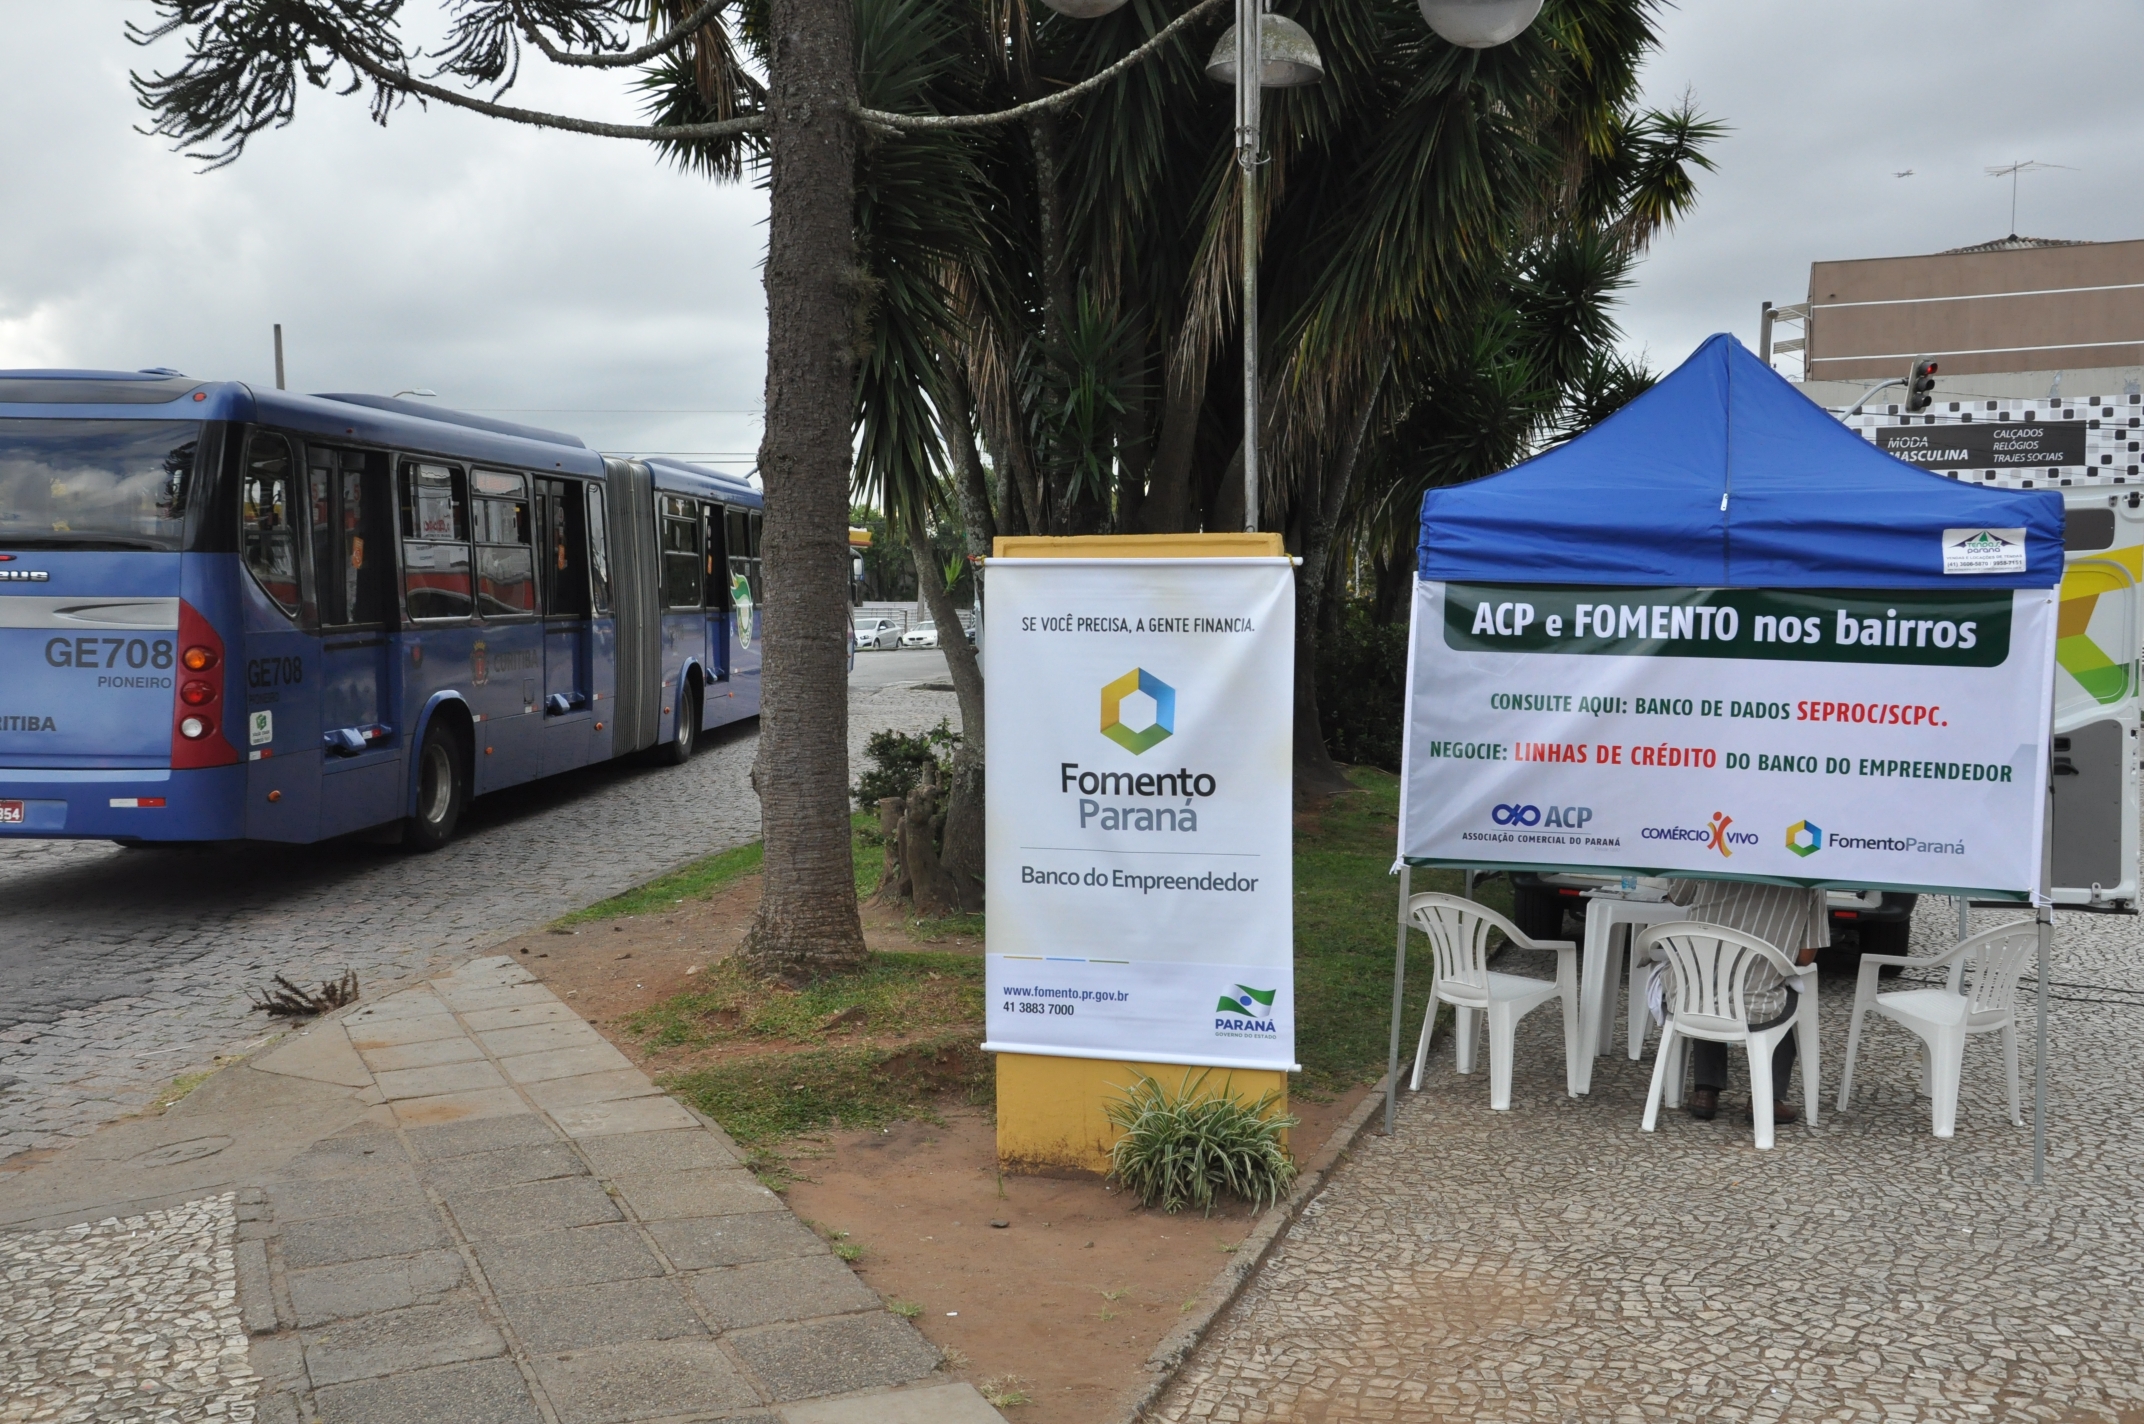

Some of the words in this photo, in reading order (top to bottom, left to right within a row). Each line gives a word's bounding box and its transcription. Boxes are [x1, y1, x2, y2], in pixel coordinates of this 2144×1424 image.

[1887, 436, 1928, 448] MODA
[1993, 429, 2044, 440] CALÇADOS
[1993, 440, 2039, 450] RELÓGIOS
[1993, 453, 2025, 463] TRAJES
[2027, 452, 2064, 462] SOCIAIS
[1021, 617, 1036, 632] SE
[1041, 613, 1074, 632] VOCÊ
[1077, 617, 1132, 634] PRECISA,
[1136, 618, 1145, 632] A
[1149, 617, 1190, 633] GENTE
[1194, 617, 1255, 633] FINANCIA.
[1471, 601, 1536, 636] ACP
[1545, 614, 1563, 636] e
[1575, 604, 1739, 641] FOMENTO
[1754, 614, 1821, 644] nos
[1836, 608, 1978, 649] bairros
[45, 637, 173, 669] GE708
[494, 649, 539, 673] CURITIBA
[98, 676, 173, 689] PIONEIRO
[248, 656, 303, 688] GE708
[1490, 693, 1572, 712] CONSULTE
[1578, 696, 1627, 717] AQUI:
[1635, 698, 1693, 716] BANCO
[1701, 699, 1723, 717] DE
[1730, 700, 1790, 720] DADOS
[1797, 700, 1948, 727] SEPROC/SCPC.
[0, 716, 57, 732] ITIBA
[1430, 741, 1508, 761] NEGOCIE:
[1514, 741, 1588, 764] LINHAS
[1596, 745, 1622, 765] DE
[1630, 742, 1717, 768] CRÉDITO
[1726, 752, 1750, 770] DO
[1758, 754, 1818, 773] BANCO
[1825, 757, 1851, 775] DO
[1859, 759, 2013, 782] EMPREENDEDOR
[1061, 763, 1216, 797] Fomento
[1079, 798, 1198, 832] Paraná
[1544, 806, 1593, 828] ACP
[1462, 832, 1514, 843] ASSOCIAÇÃO
[1518, 835, 1566, 845] COMERCIAL
[1570, 837, 1582, 845] DO
[1585, 837, 1621, 847] PARANÁ
[1641, 826, 1710, 842] COMÉRCIO
[1726, 832, 1759, 845] VIVO
[1829, 833, 1965, 855] FomentoParaná
[1021, 866, 1080, 886] Banco
[1083, 867, 1108, 887] do
[1112, 869, 1258, 894] Empreendedor
[1003, 985, 1129, 1003] www.fomento.pr.gov.br
[1003, 1002, 1015, 1013] 41
[1019, 1002, 1045, 1014] 3883
[1048, 1004, 1075, 1016] 7000
[1215, 1018, 1276, 1032] PARANÁ
